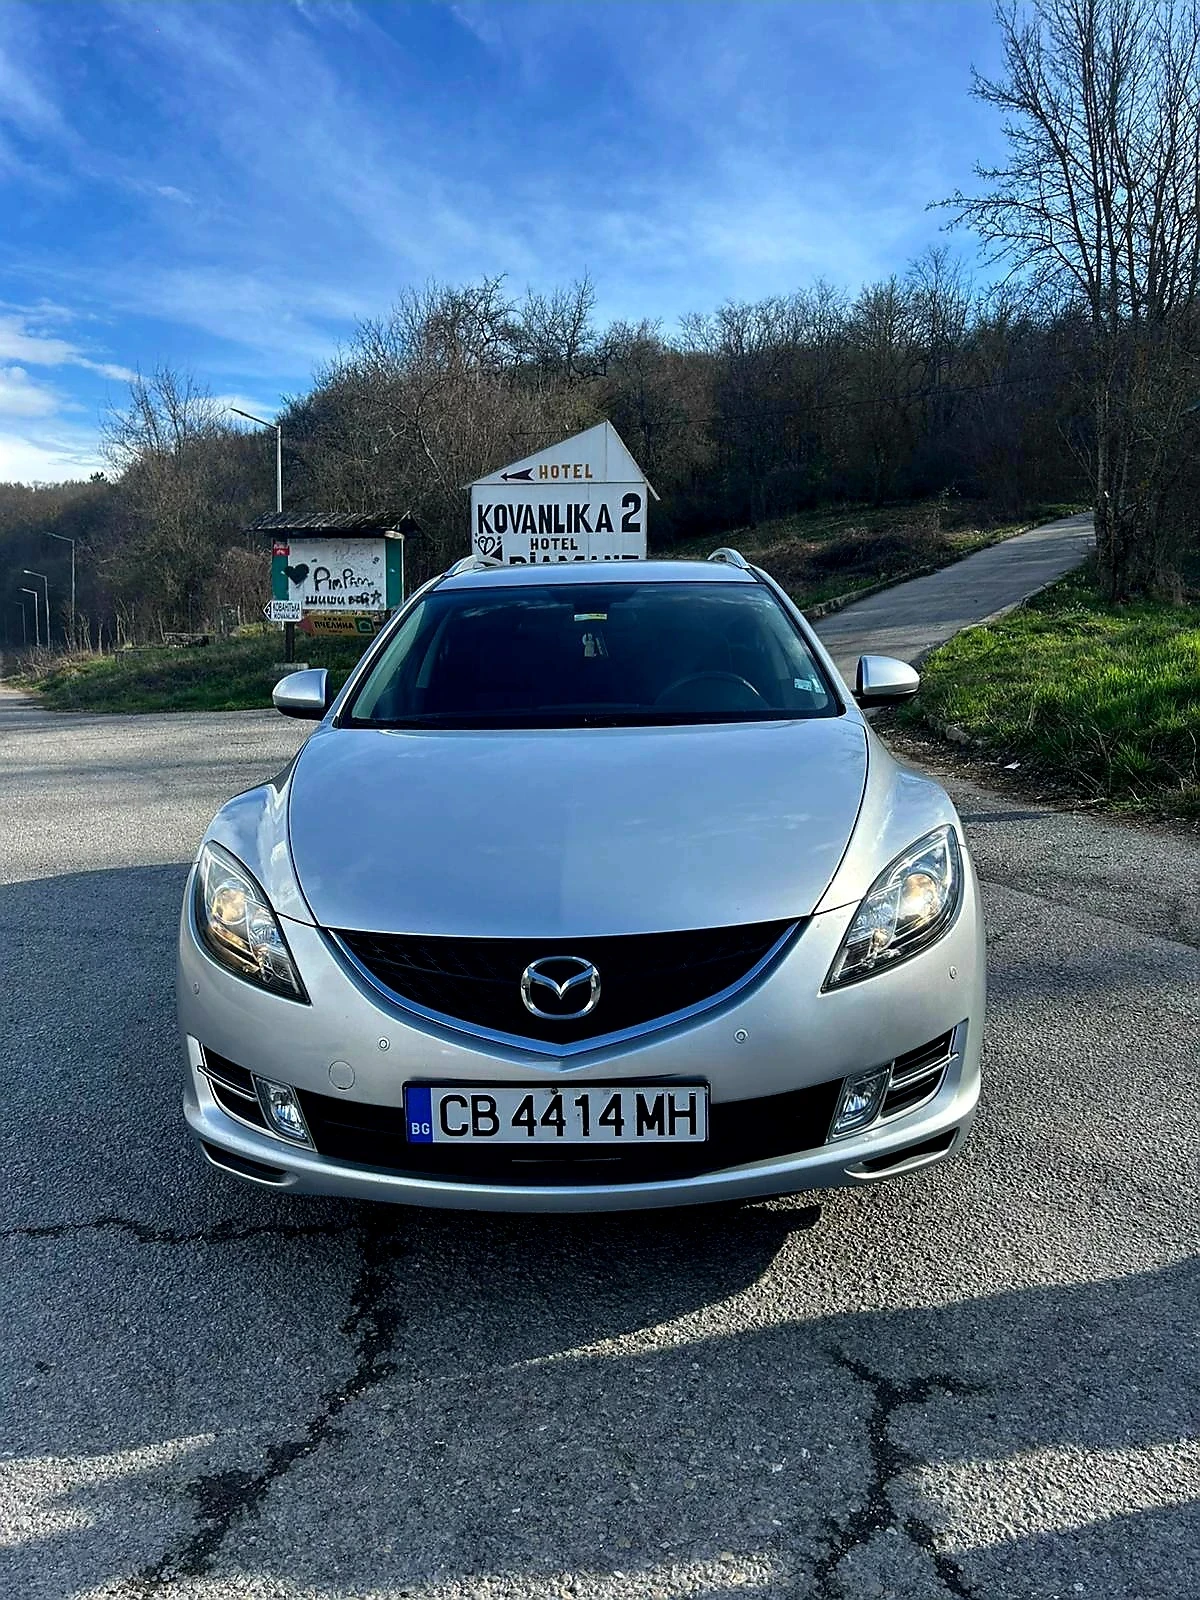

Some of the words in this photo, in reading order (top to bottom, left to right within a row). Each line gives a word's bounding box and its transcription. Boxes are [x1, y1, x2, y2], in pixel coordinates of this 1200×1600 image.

[539, 464, 592, 479] HOTEL
[477, 503, 614, 534] KOVANLIKA
[621, 493, 642, 533] 2
[530, 538, 578, 550] HOTEL
[411, 1122, 430, 1135] BG
[439, 1093, 500, 1137] CB
[511, 1093, 625, 1137] 4414
[636, 1092, 697, 1136] MH
